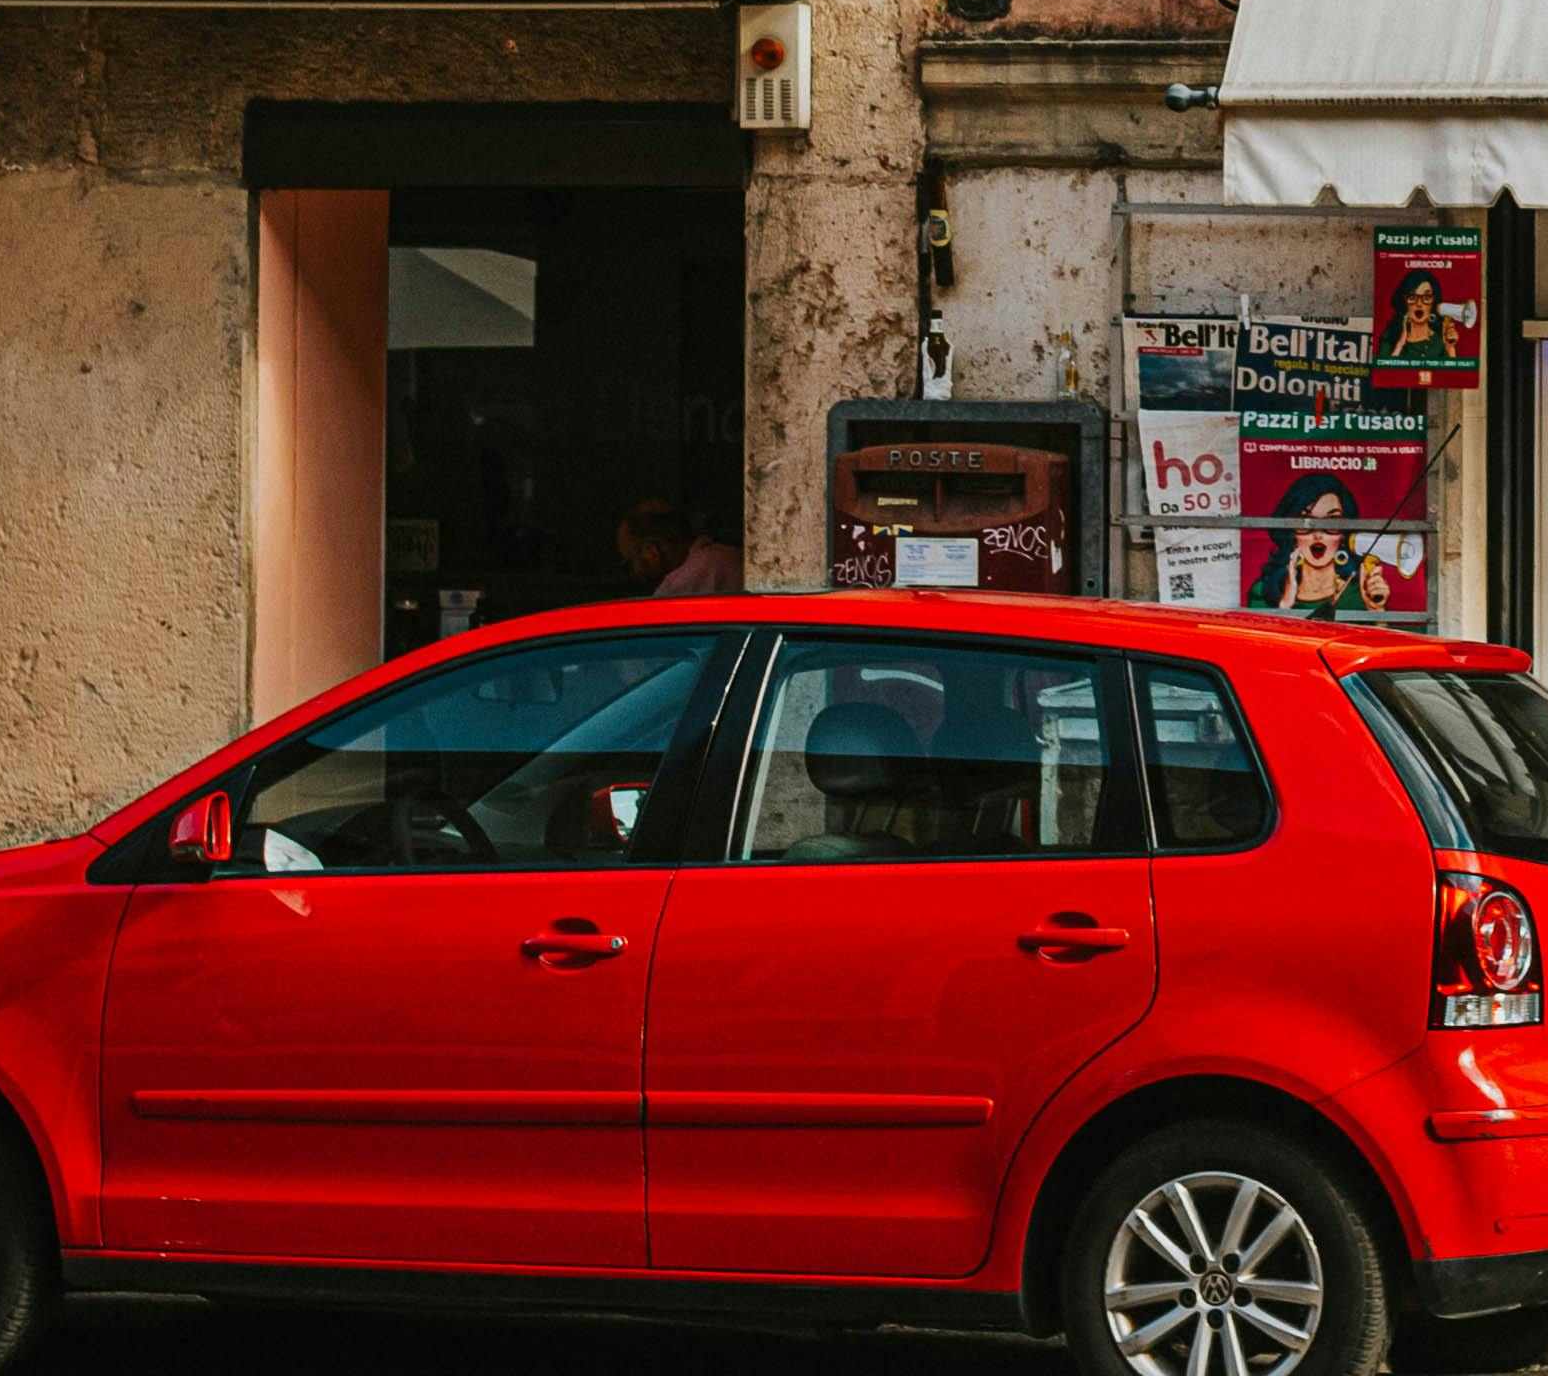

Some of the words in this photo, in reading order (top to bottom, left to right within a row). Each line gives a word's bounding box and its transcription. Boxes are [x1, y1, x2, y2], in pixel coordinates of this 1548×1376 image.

[1378, 233, 1409, 245] Pazzi
[1412, 235, 1432, 246] per
[1436, 234, 1478, 246] l'usato!
[1235, 366, 1361, 402] Dolomiti
[1242, 411, 1299, 429] Pazzi
[1304, 415, 1340, 433] per
[1345, 413, 1425, 431] l'usato!
[889, 450, 982, 468] POSTE
[1152, 440, 1233, 490] ho.
[1160, 502, 1179, 515] Da
[1183, 492, 1211, 511] 50
[1165, 545, 1191, 555] Entra
